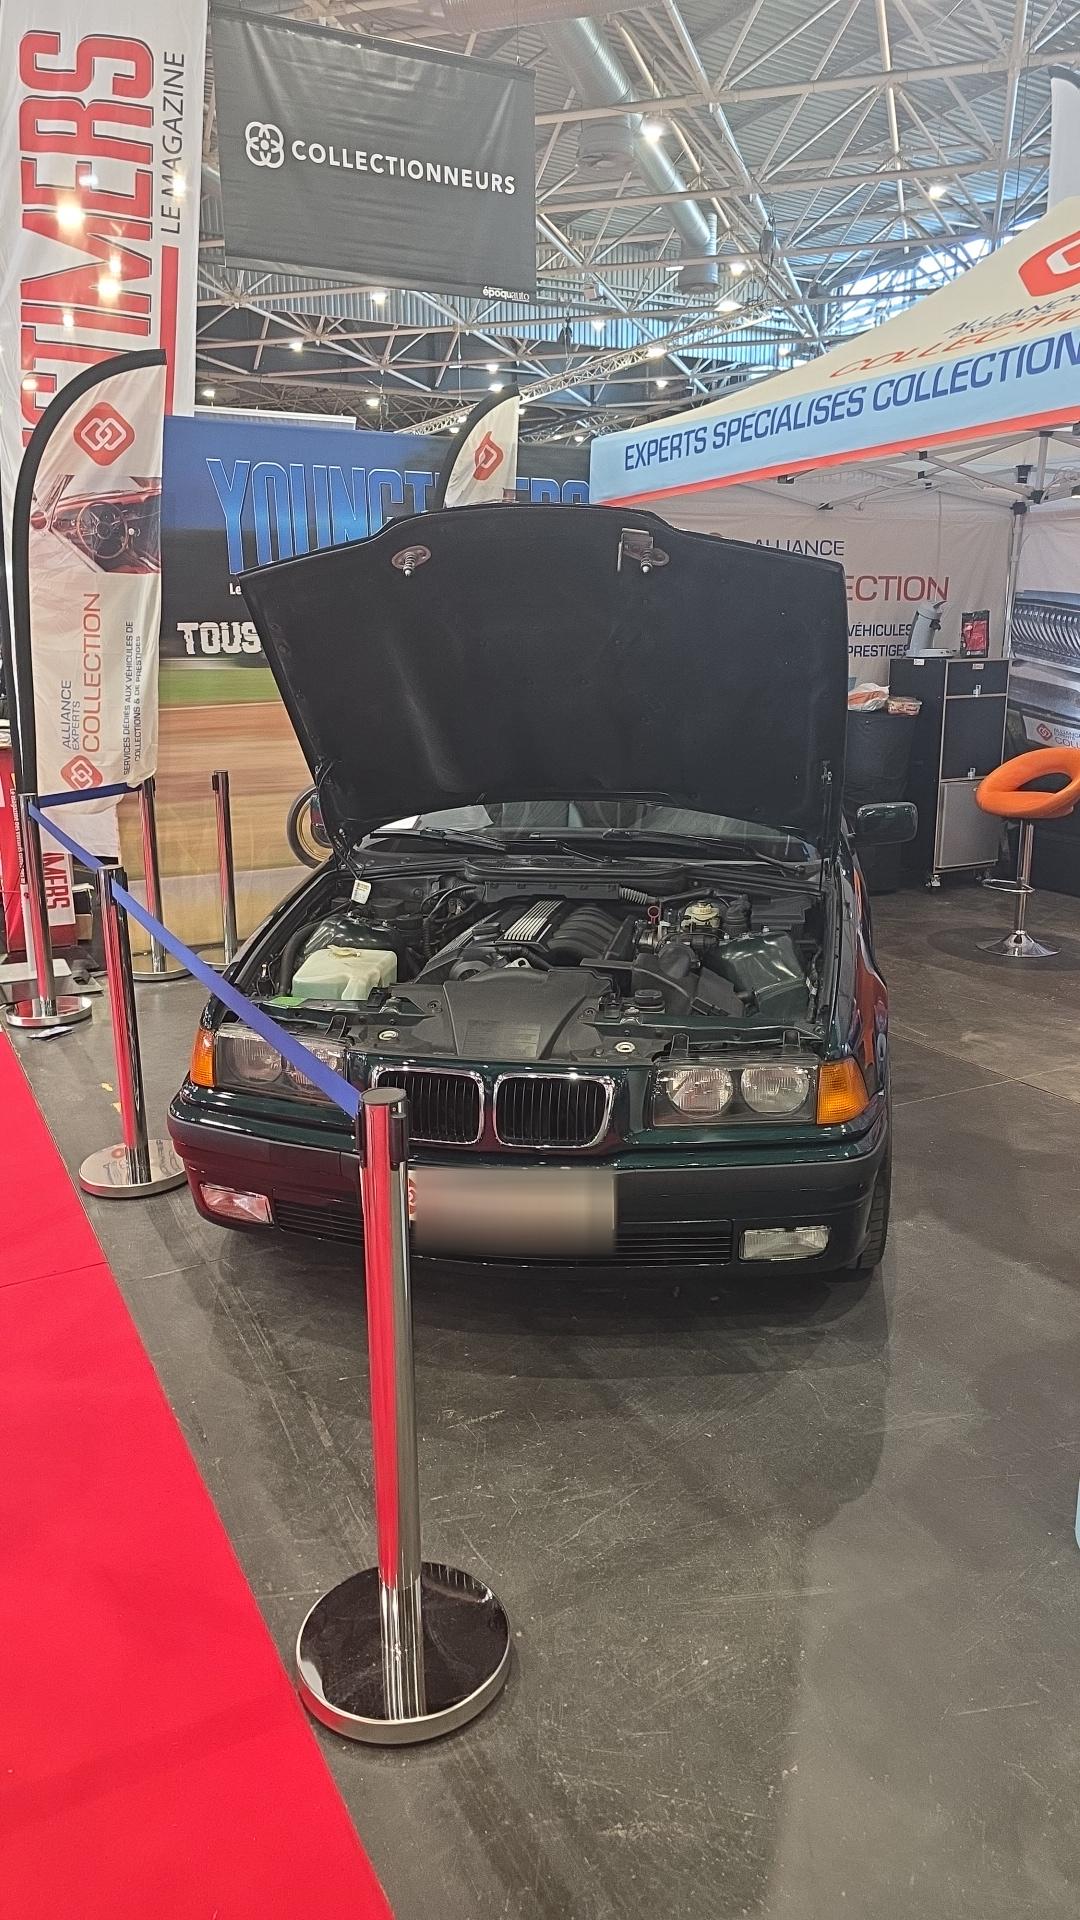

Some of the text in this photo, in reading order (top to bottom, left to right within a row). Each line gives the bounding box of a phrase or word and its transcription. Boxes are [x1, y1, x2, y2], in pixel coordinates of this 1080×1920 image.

[161, 51, 185, 234] LE MAGAZINE
[291, 139, 516, 195] COLLECTIONNEURS
[625, 427, 708, 471] EXPERTS
[873, 331, 1080, 412] COLLECTION
[125, 621, 134, 633] DE
[177, 621, 262, 656] TOUS
[848, 621, 912, 637] VÉHICULES
[82, 593, 101, 753] COLLECTION
[60, 680, 72, 749] ALLIANCE
[71, 701, 81, 751] EXPERTS
[123, 736, 131, 776] SERVICES
